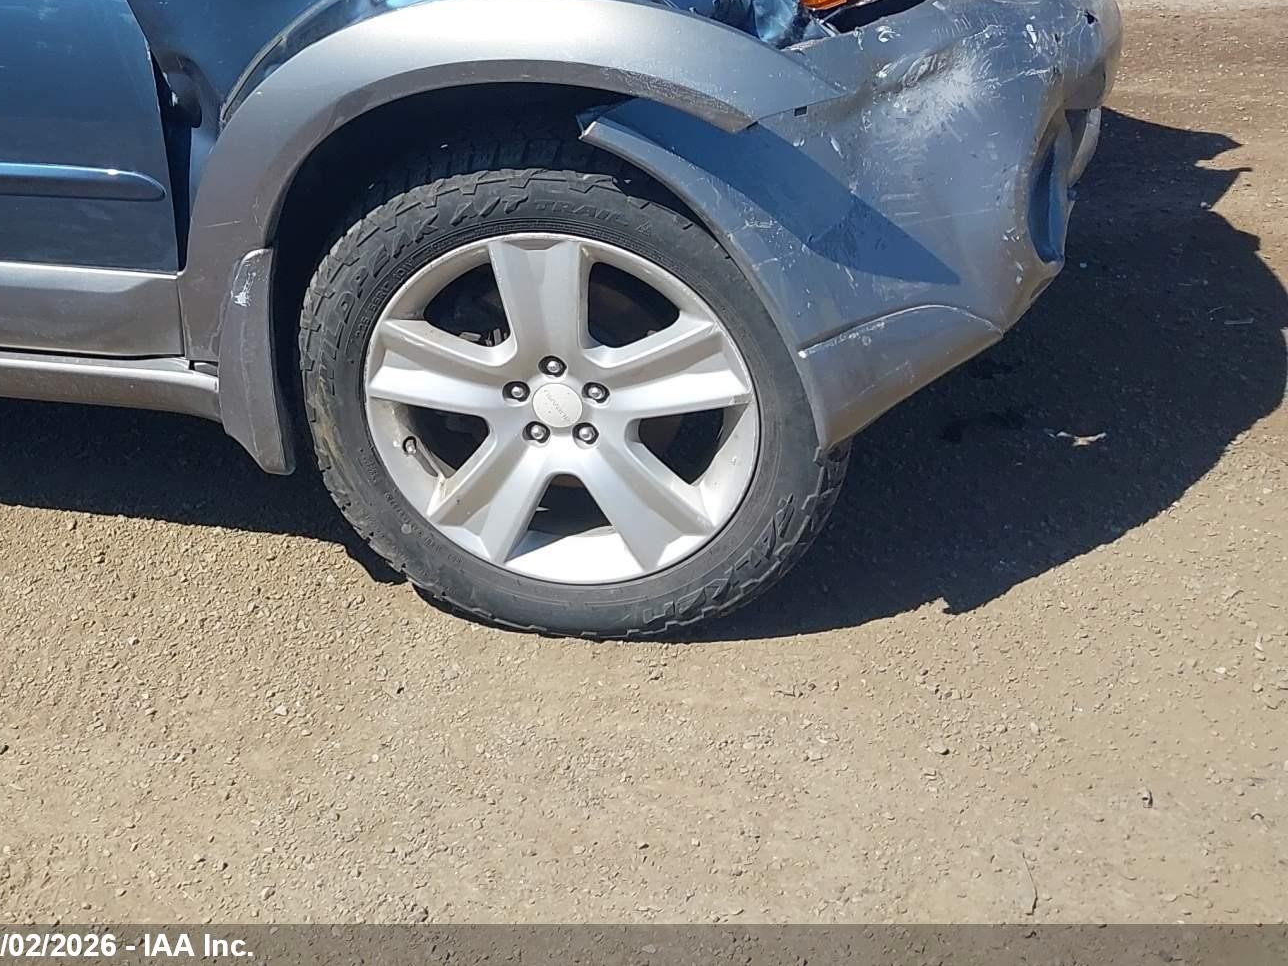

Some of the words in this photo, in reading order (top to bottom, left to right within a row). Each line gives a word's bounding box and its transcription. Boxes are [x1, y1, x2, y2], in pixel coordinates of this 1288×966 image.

[317, 213, 441, 397] WILDPEAK
[449, 194, 529, 227] A/T
[534, 199, 629, 227] TRAIL
